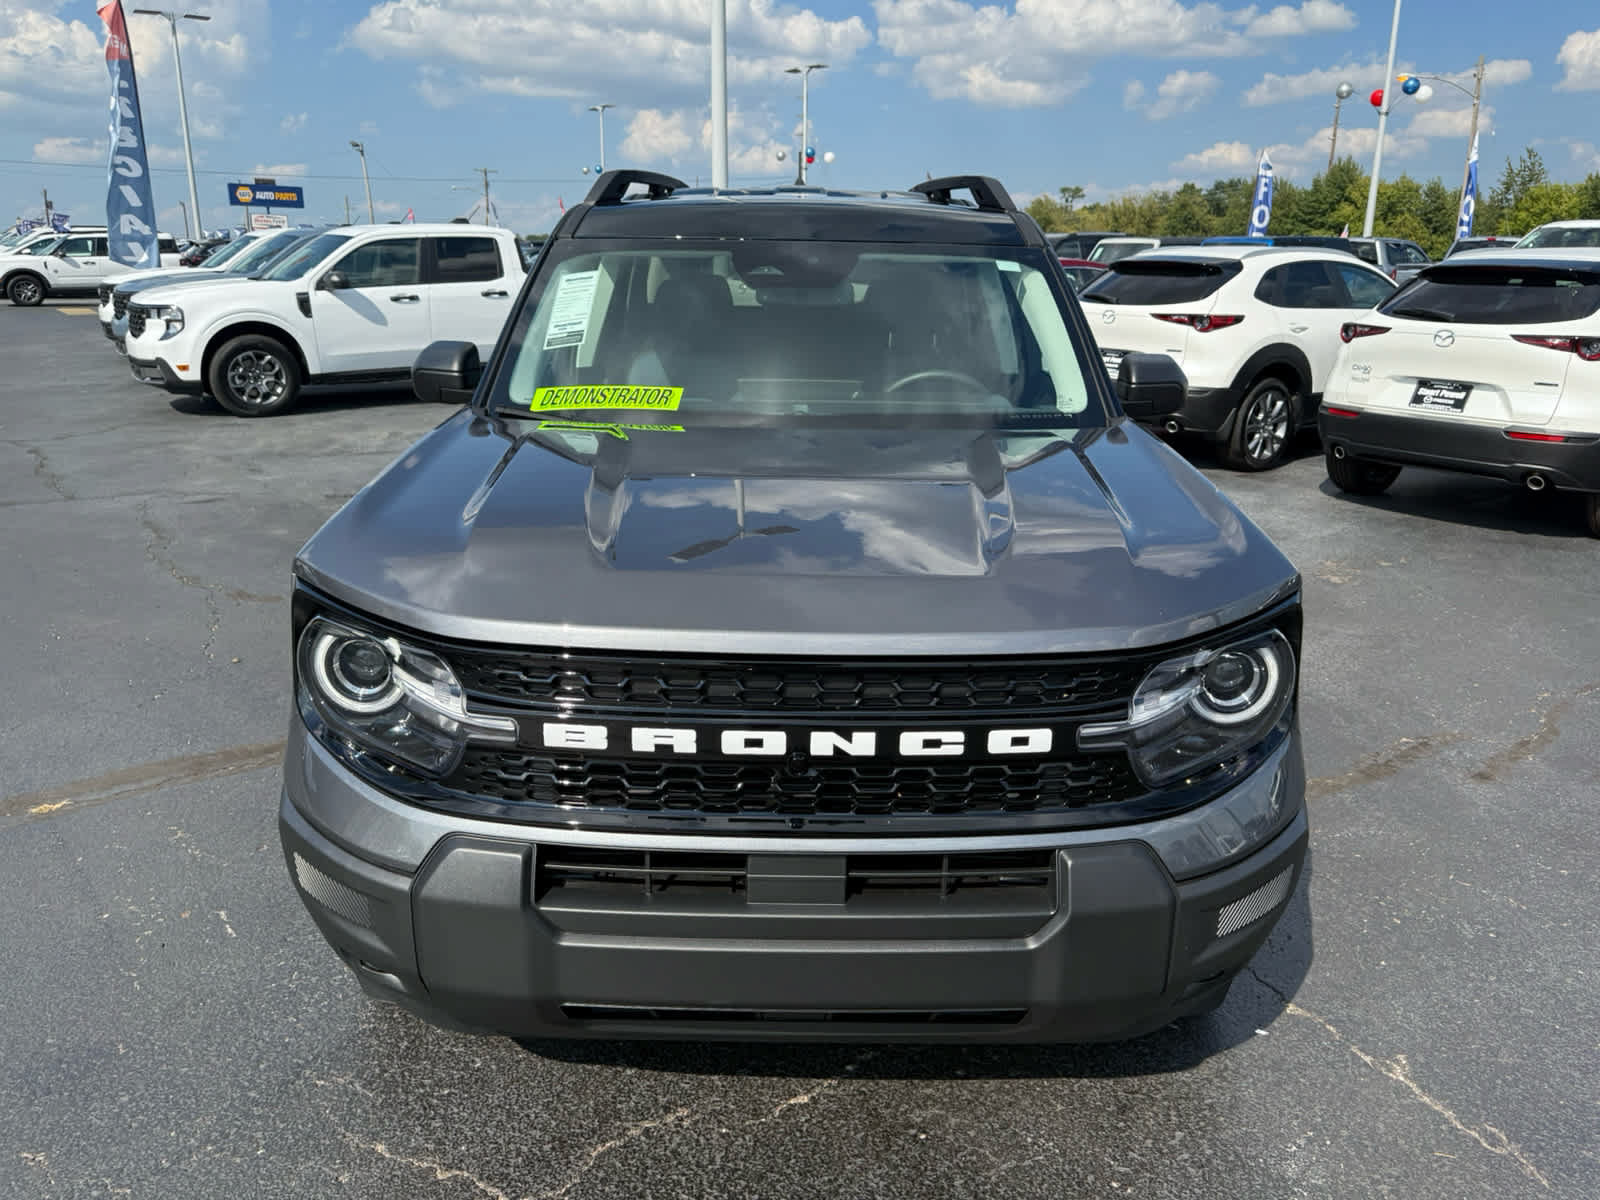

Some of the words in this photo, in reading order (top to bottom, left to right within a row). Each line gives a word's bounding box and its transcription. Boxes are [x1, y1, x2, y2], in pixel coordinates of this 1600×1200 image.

[255, 191, 275, 200] AUTO
[275, 192, 297, 201] PARTS
[1252, 175, 1271, 237] FO
[540, 387, 673, 407] DEMONSTRATOR
[542, 722, 1053, 757] BRONCO
